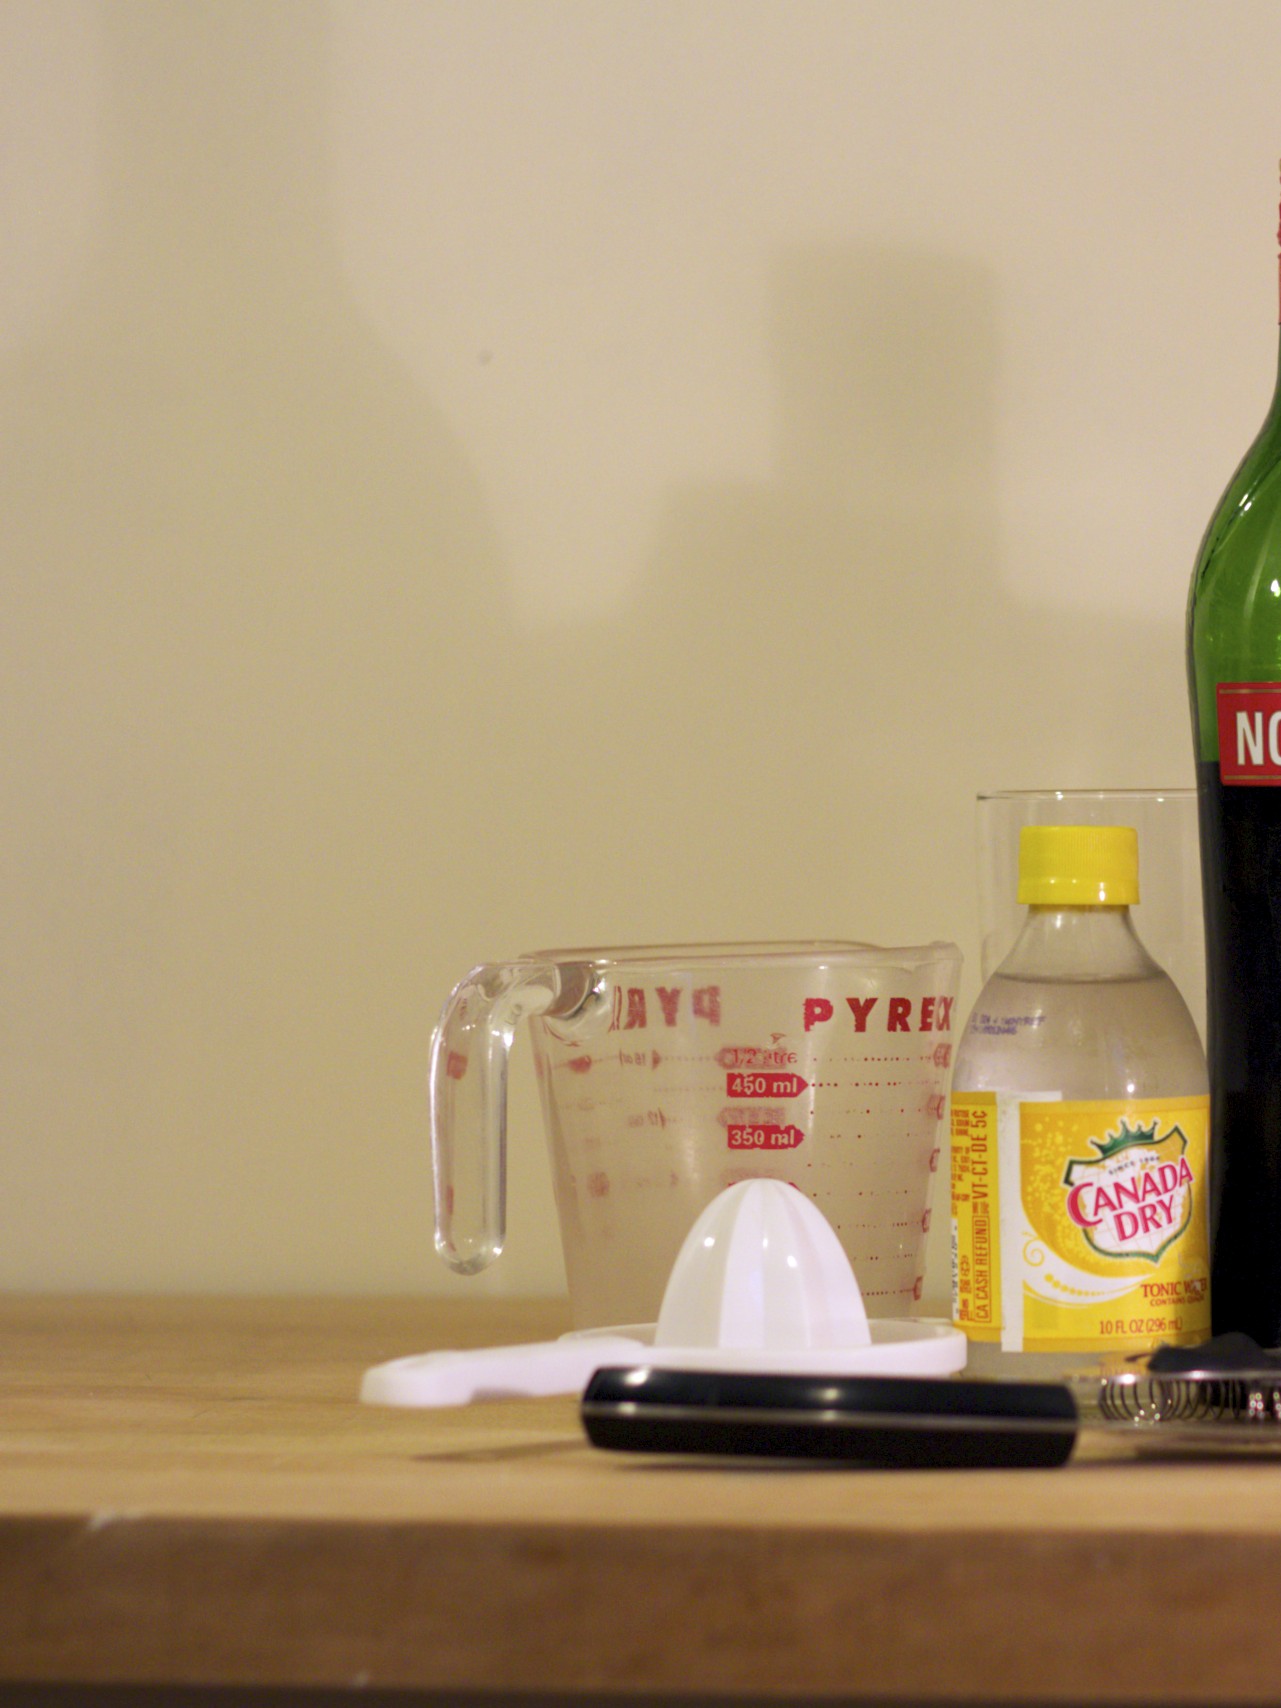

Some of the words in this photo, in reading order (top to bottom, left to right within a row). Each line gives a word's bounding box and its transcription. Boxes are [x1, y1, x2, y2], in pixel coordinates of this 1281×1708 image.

[804, 996, 954, 1032] PYREX
[731, 1076, 766, 1094] 450
[773, 1077, 798, 1093] ml
[731, 1128, 764, 1145] 350
[770, 1128, 795, 1145] ml
[971, 1134, 988, 1199] VT-CT-DE
[1067, 1157, 1193, 1228] CANADA
[1114, 1195, 1174, 1241] DRY
[974, 1219, 988, 1265] REFUND
[975, 1270, 989, 1300] CASH
[1140, 1281, 1181, 1298] TONIC
[975, 1304, 989, 1319] CA
[1099, 1320, 1113, 1335] 10
[1115, 1319, 1127, 1334] FL
[1129, 1319, 1144, 1334] OZ
